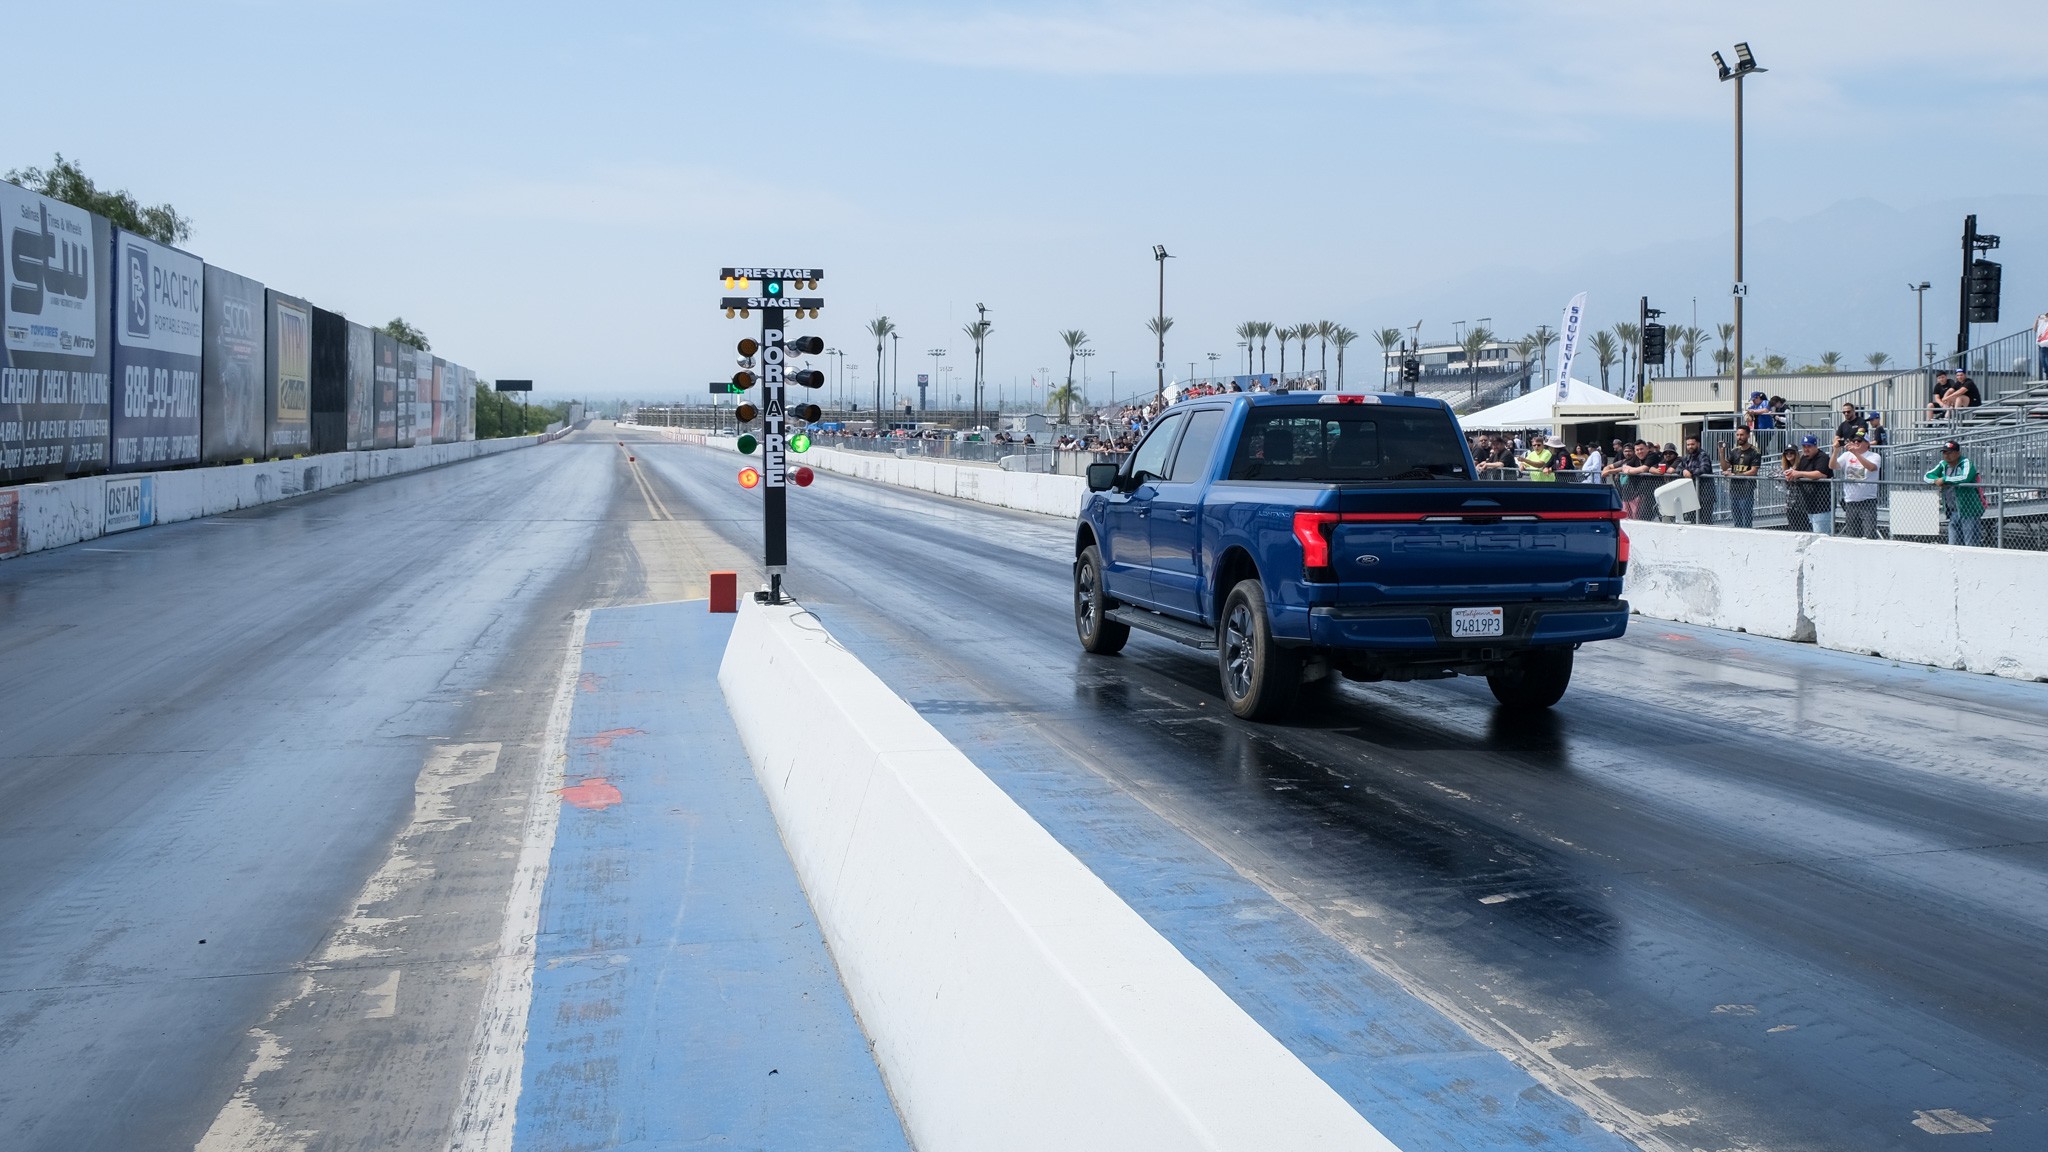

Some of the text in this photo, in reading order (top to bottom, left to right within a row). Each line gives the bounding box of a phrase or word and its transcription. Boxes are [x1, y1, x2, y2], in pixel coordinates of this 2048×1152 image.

[734, 268, 811, 278] PRE-STAGE
[154, 266, 199, 313] PACIFIC
[1733, 284, 1747, 295] A-1
[747, 298, 800, 307] STAGE
[155, 314, 180, 333] PORTABLE
[74, 336, 94, 349] NITTO
[1560, 306, 1580, 388] SOUVENIRS
[2, 368, 108, 404] CREDIT CHECK FINANCING
[124, 365, 198, 417] 888-99-PORTA
[27, 421, 37, 440] LA
[40, 421, 66, 439] PUENTE
[68, 419, 108, 437] WESTMINSTER
[108, 485, 139, 515] OSTAR
[1462, 609, 1492, 618] California
[1455, 618, 1500, 633] 94819P3
